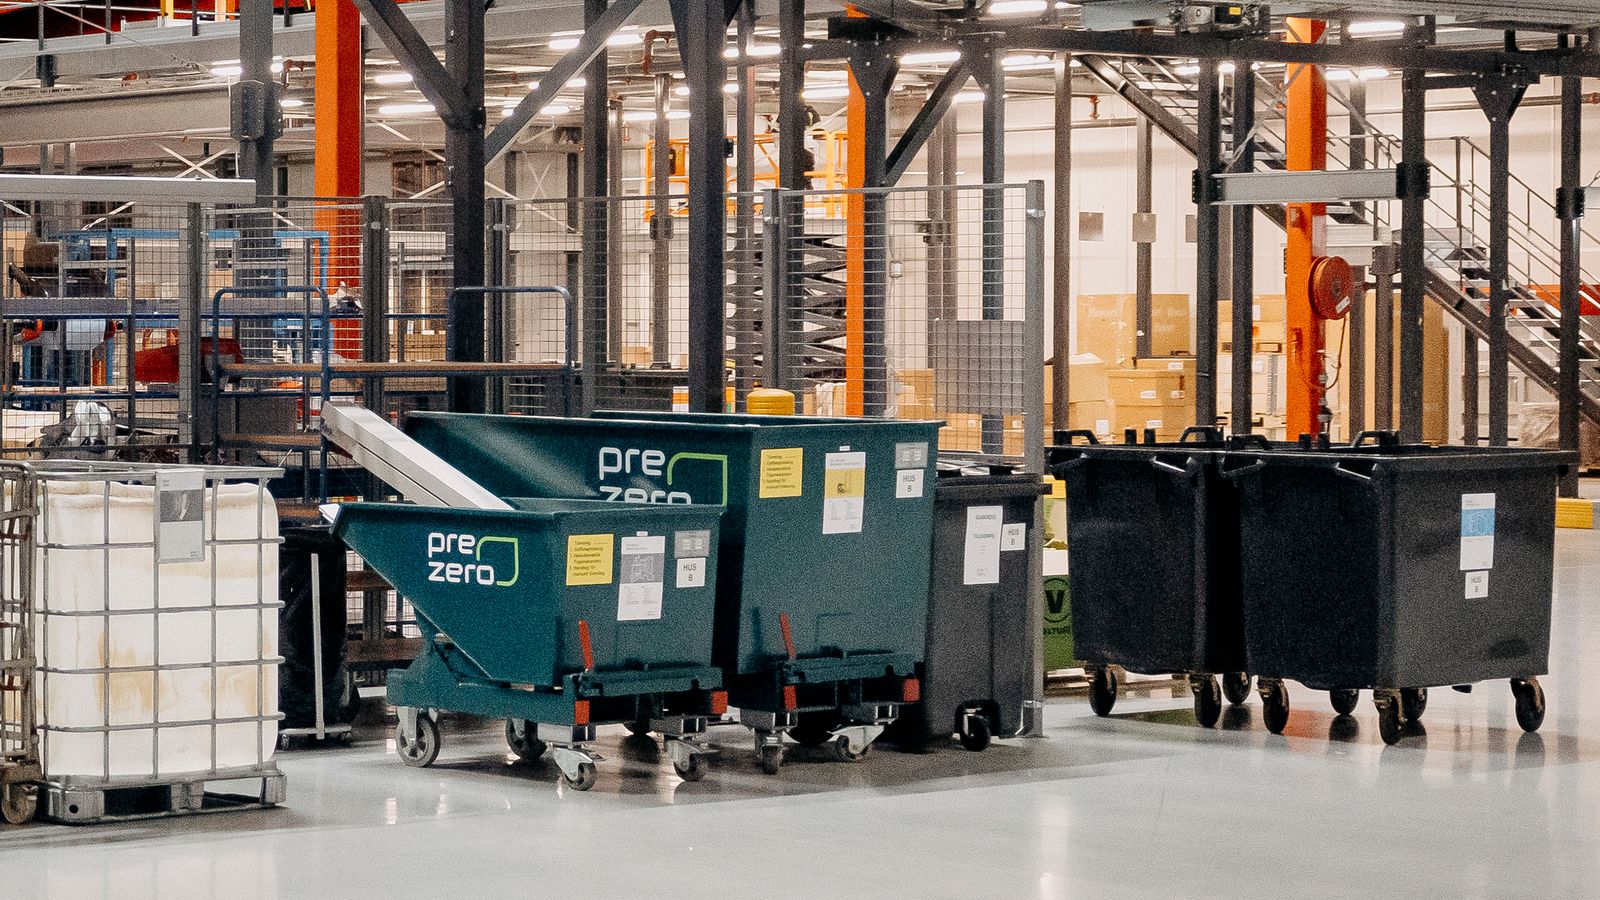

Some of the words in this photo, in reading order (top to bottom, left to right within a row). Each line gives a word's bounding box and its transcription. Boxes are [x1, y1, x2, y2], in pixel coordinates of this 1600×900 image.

[599, 446, 666, 480] pre
[902, 475, 916, 483] HUS
[428, 532, 476, 558] pre
[428, 561, 495, 585] zero
[683, 563, 697, 571] HUS
[688, 574, 694, 582] B
[1045, 590, 1066, 614] V
